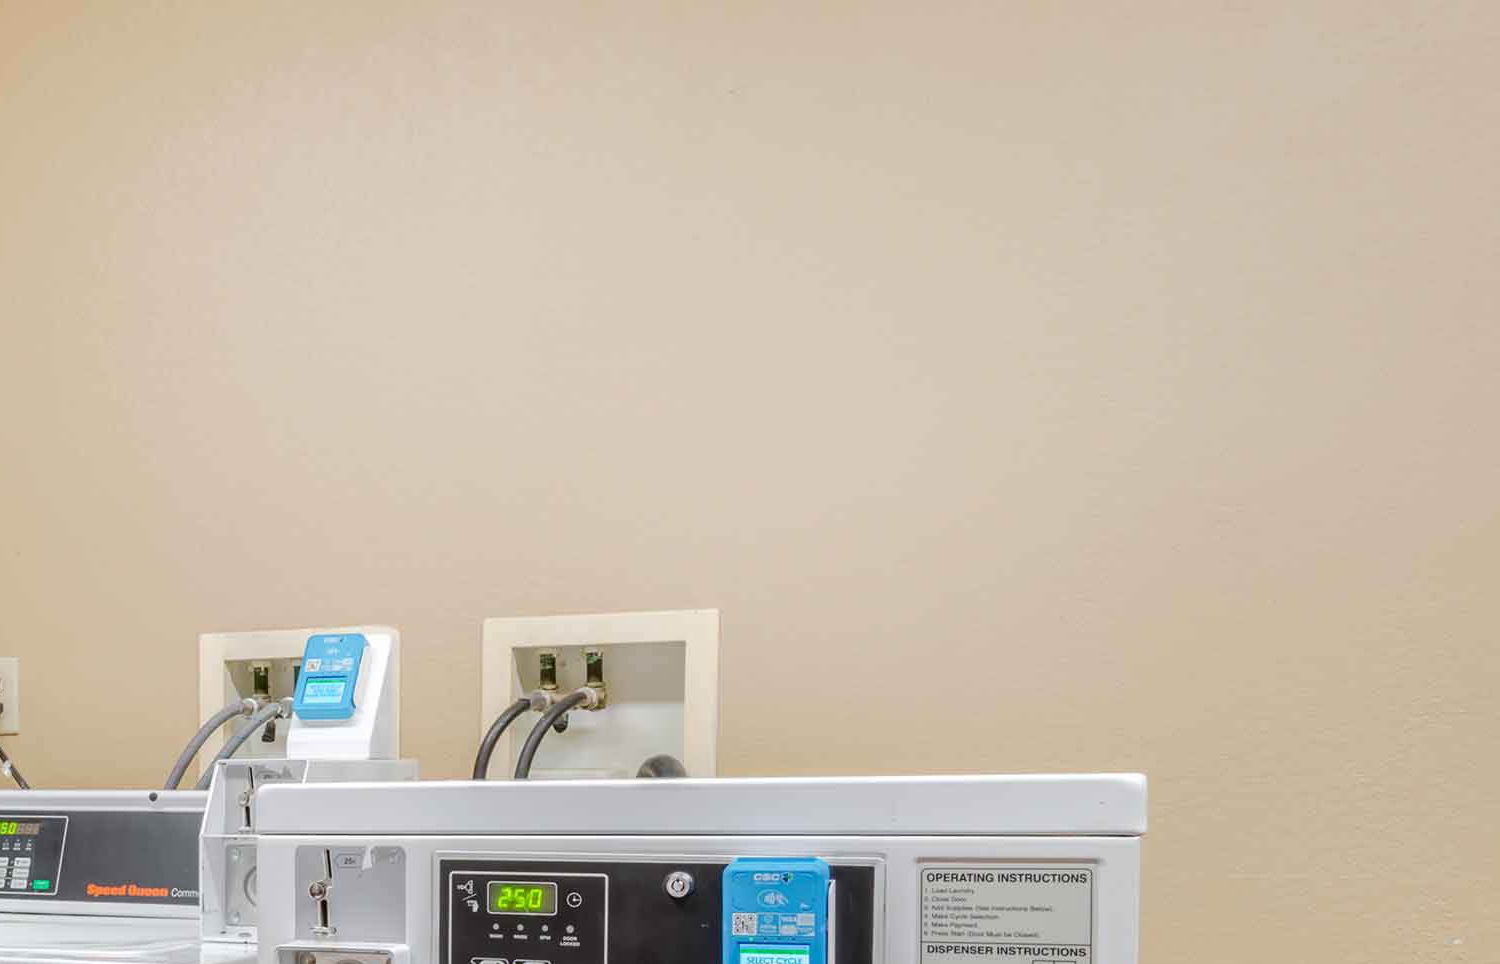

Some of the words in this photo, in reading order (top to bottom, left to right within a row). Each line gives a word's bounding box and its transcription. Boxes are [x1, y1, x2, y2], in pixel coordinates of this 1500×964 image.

[926, 872, 994, 883] OPERATING
[997, 873, 1088, 884] INSTRUCTIONS
[86, 883, 126, 897] Speed
[128, 884, 169, 897] Queen
[927, 945, 993, 955] DISPENSER
[996, 946, 1087, 957] INSTRUCTIONS
[746, 956, 773, 964] SELECT
[776, 957, 804, 964] CYCLE
